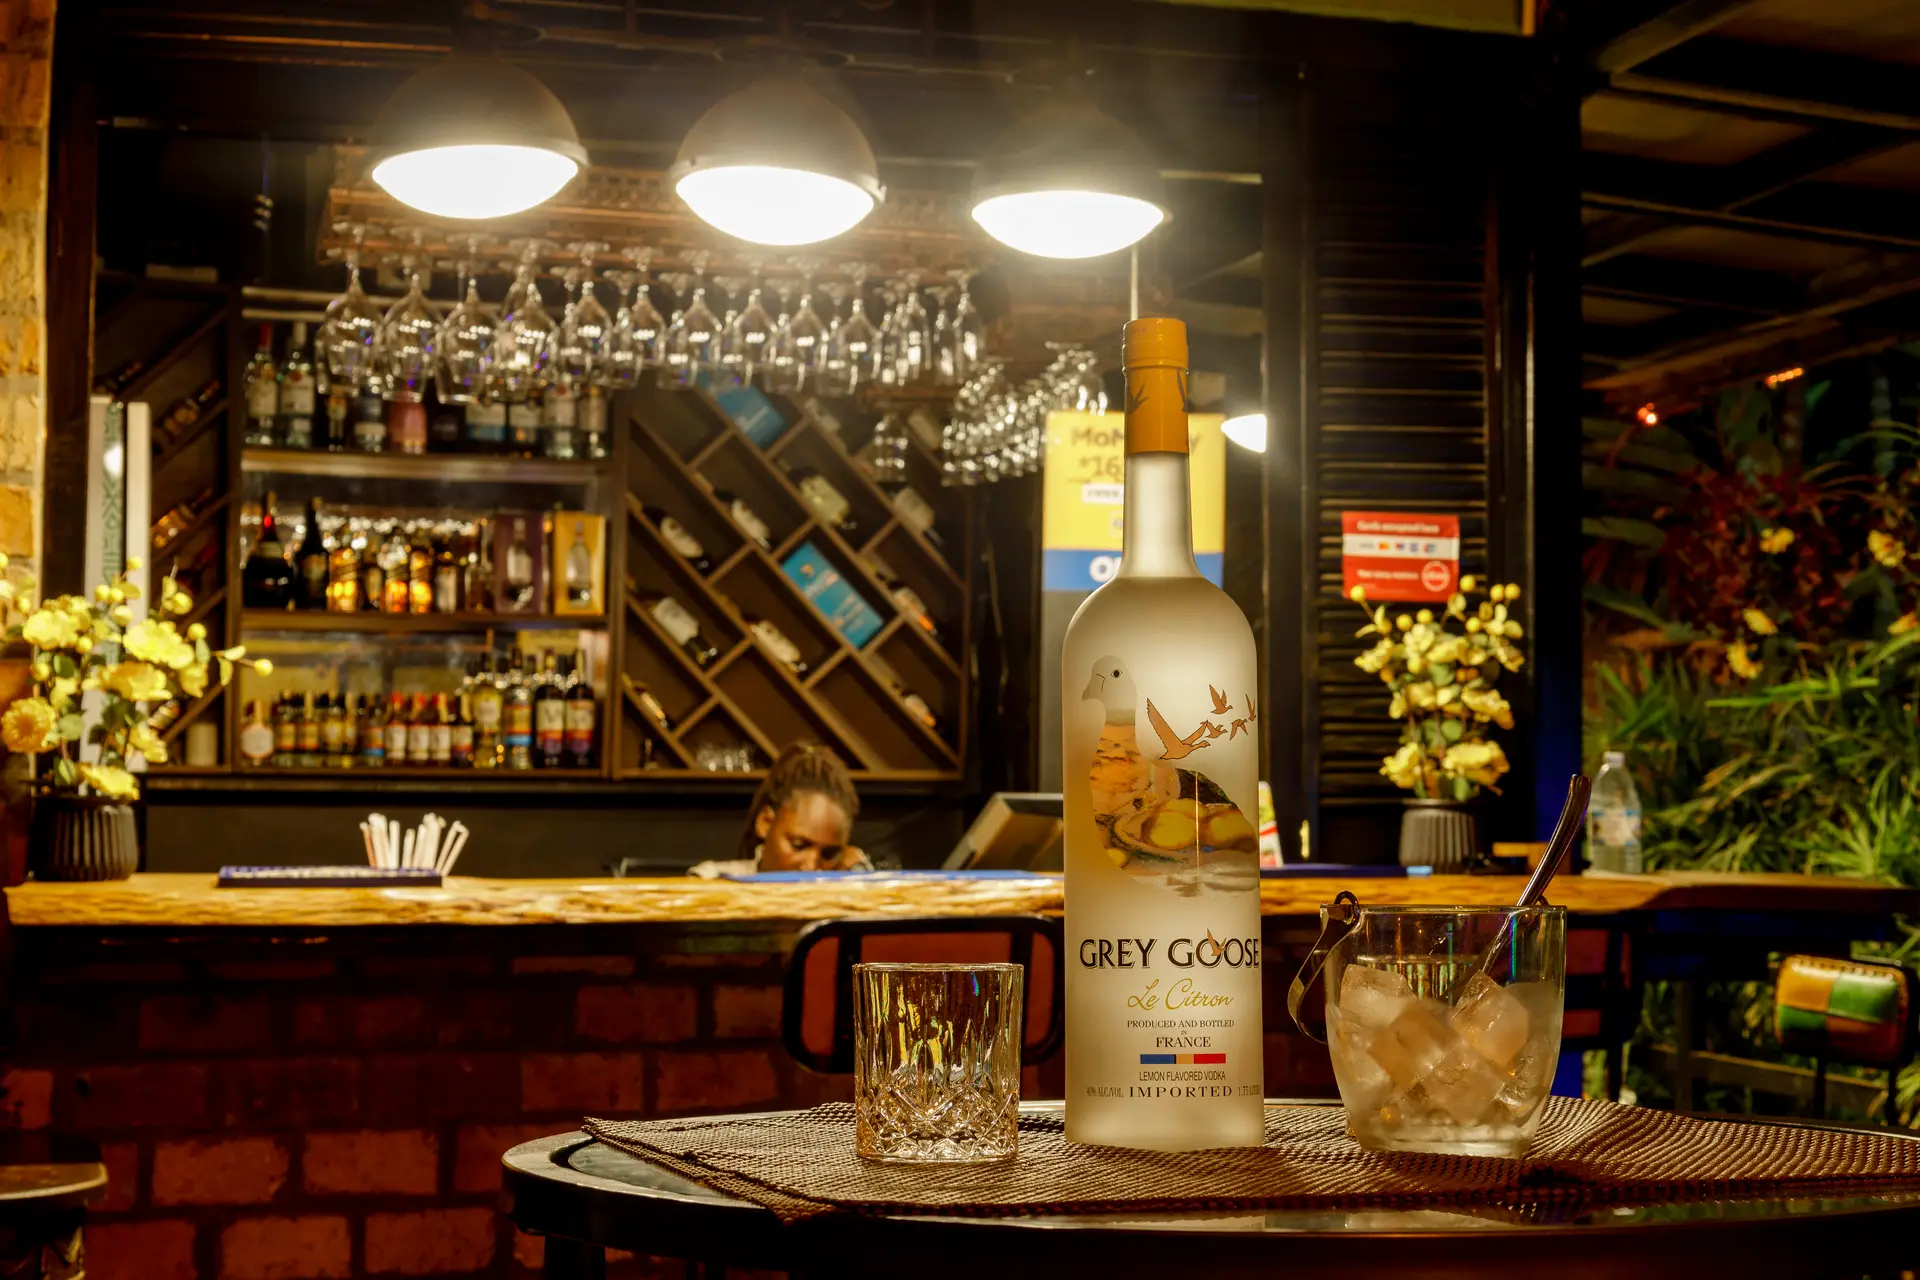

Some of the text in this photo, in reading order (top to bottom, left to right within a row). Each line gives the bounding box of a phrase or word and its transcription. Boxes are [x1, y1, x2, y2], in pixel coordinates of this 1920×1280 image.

[1079, 937, 1261, 969] GREY GOOSE
[1127, 977, 1234, 1011] Le Citron
[1127, 1019, 1235, 1028] PRODUCED AND BOTTLED
[1155, 1036, 1212, 1048] FRANCE
[1139, 1070, 1226, 1082] LEMON FLAVORED VODKA
[1129, 1086, 1233, 1098] IMPORTED
